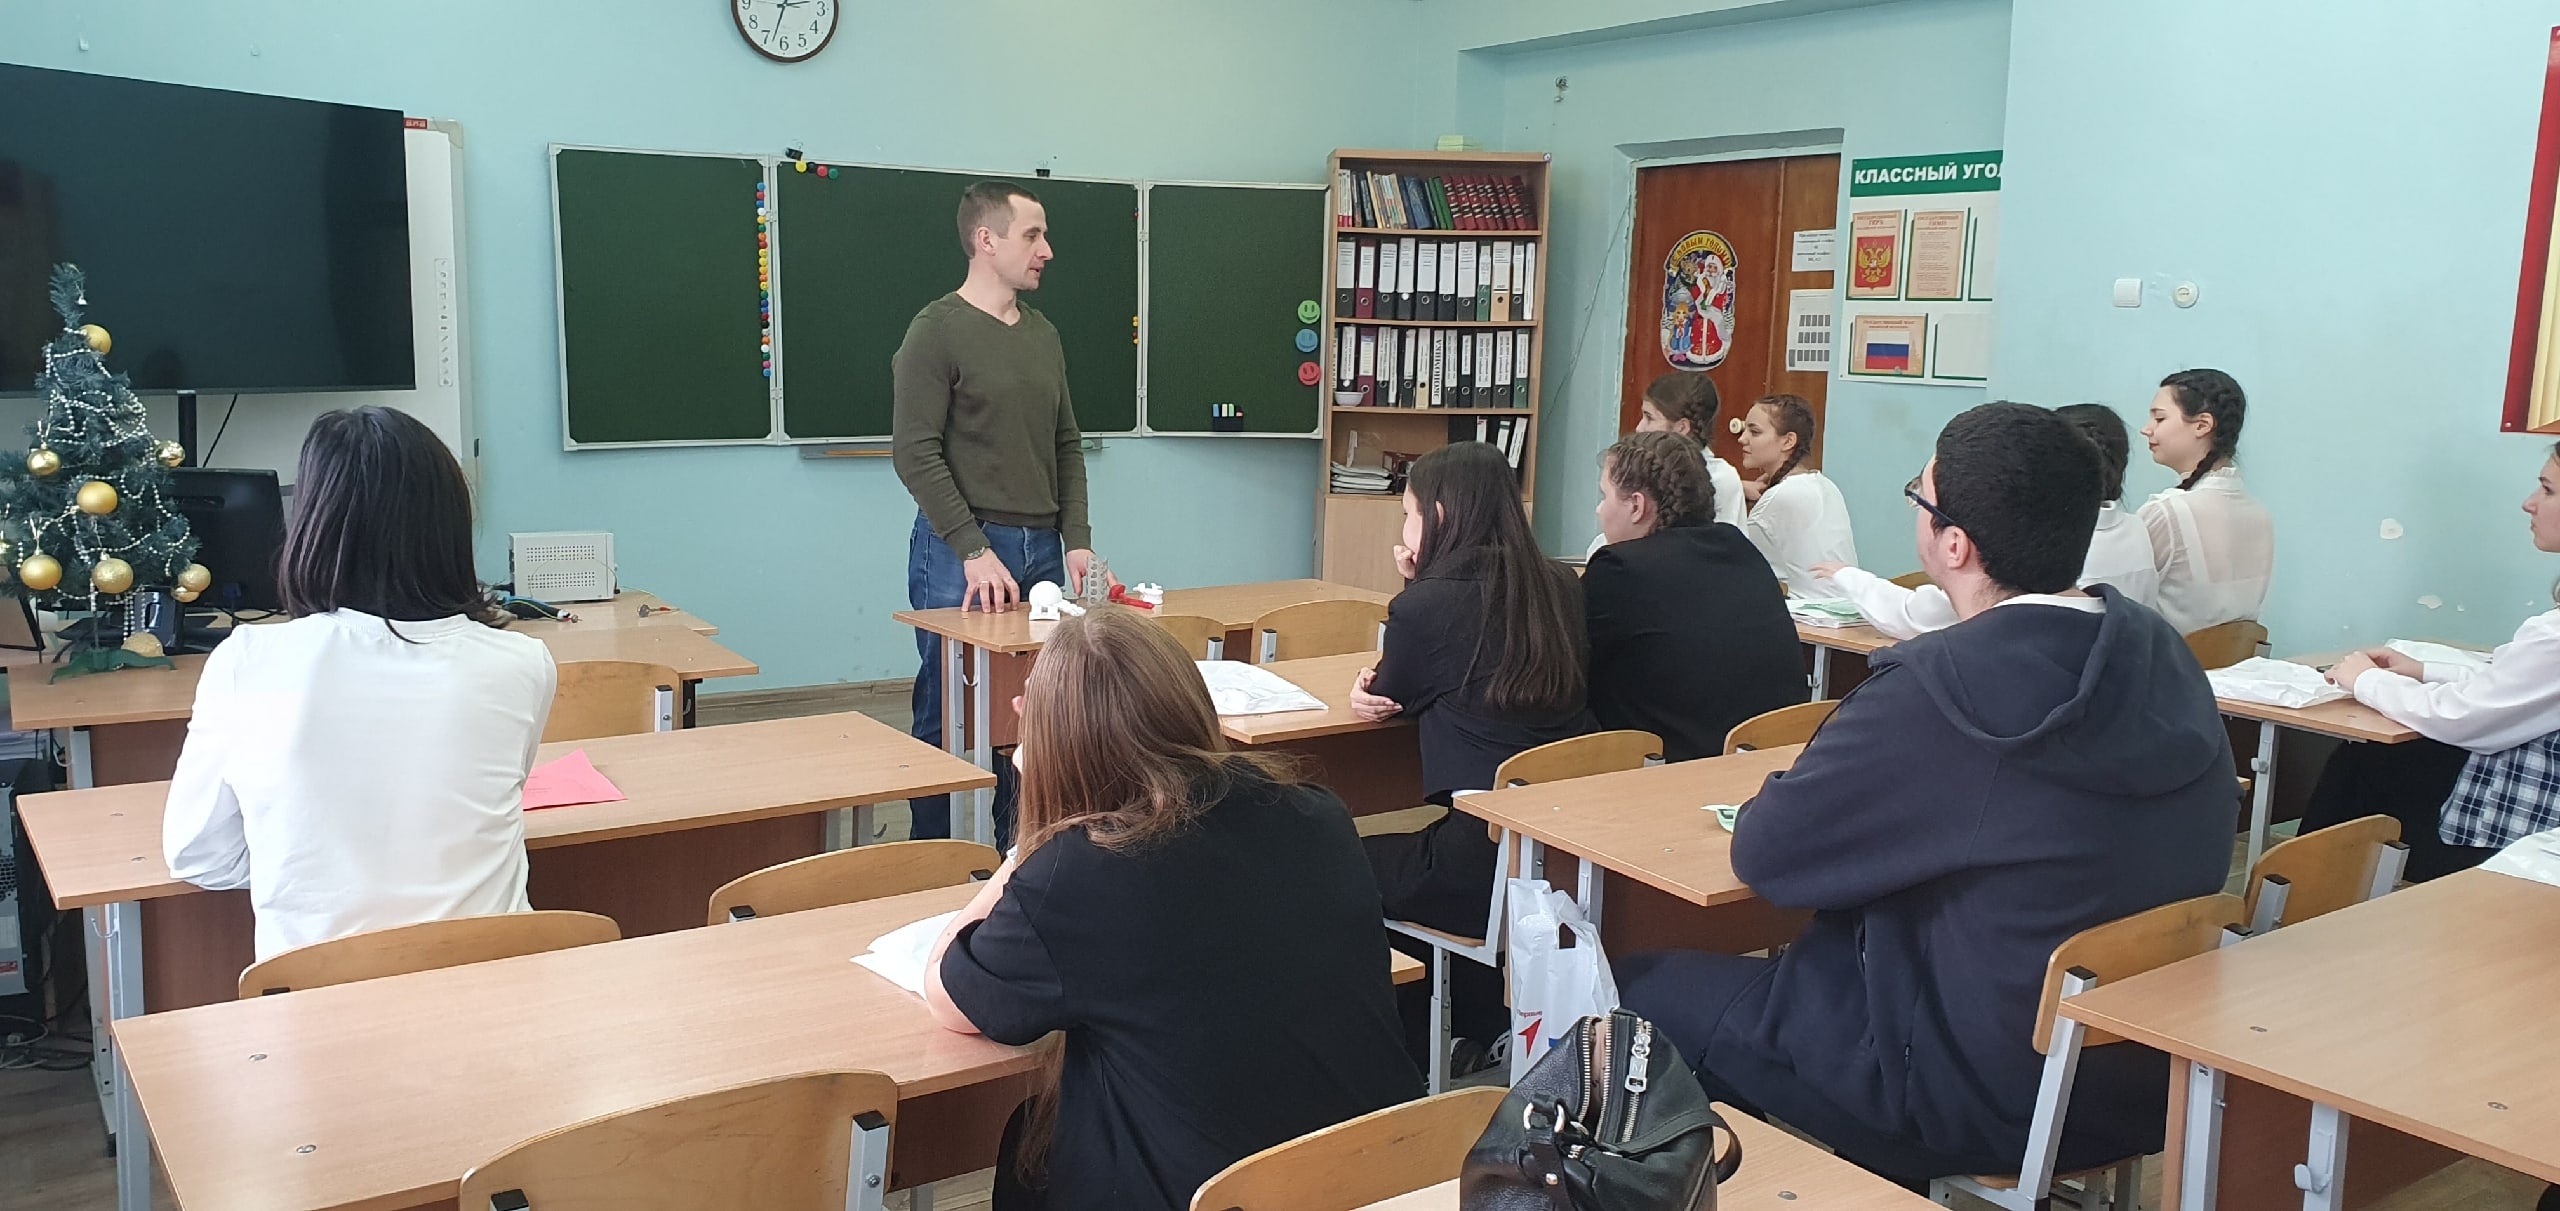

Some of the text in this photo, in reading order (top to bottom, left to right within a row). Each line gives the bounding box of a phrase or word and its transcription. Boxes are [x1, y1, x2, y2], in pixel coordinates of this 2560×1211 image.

[817, 1, 826, 16] 3
[749, 15, 758, 29] 8
[809, 20, 818, 34] 4
[761, 30, 770, 44] 7
[779, 36, 789, 51] 6
[798, 34, 807, 47] 5
[1854, 162, 2002, 184] КЛАССНЫЙ УГО
